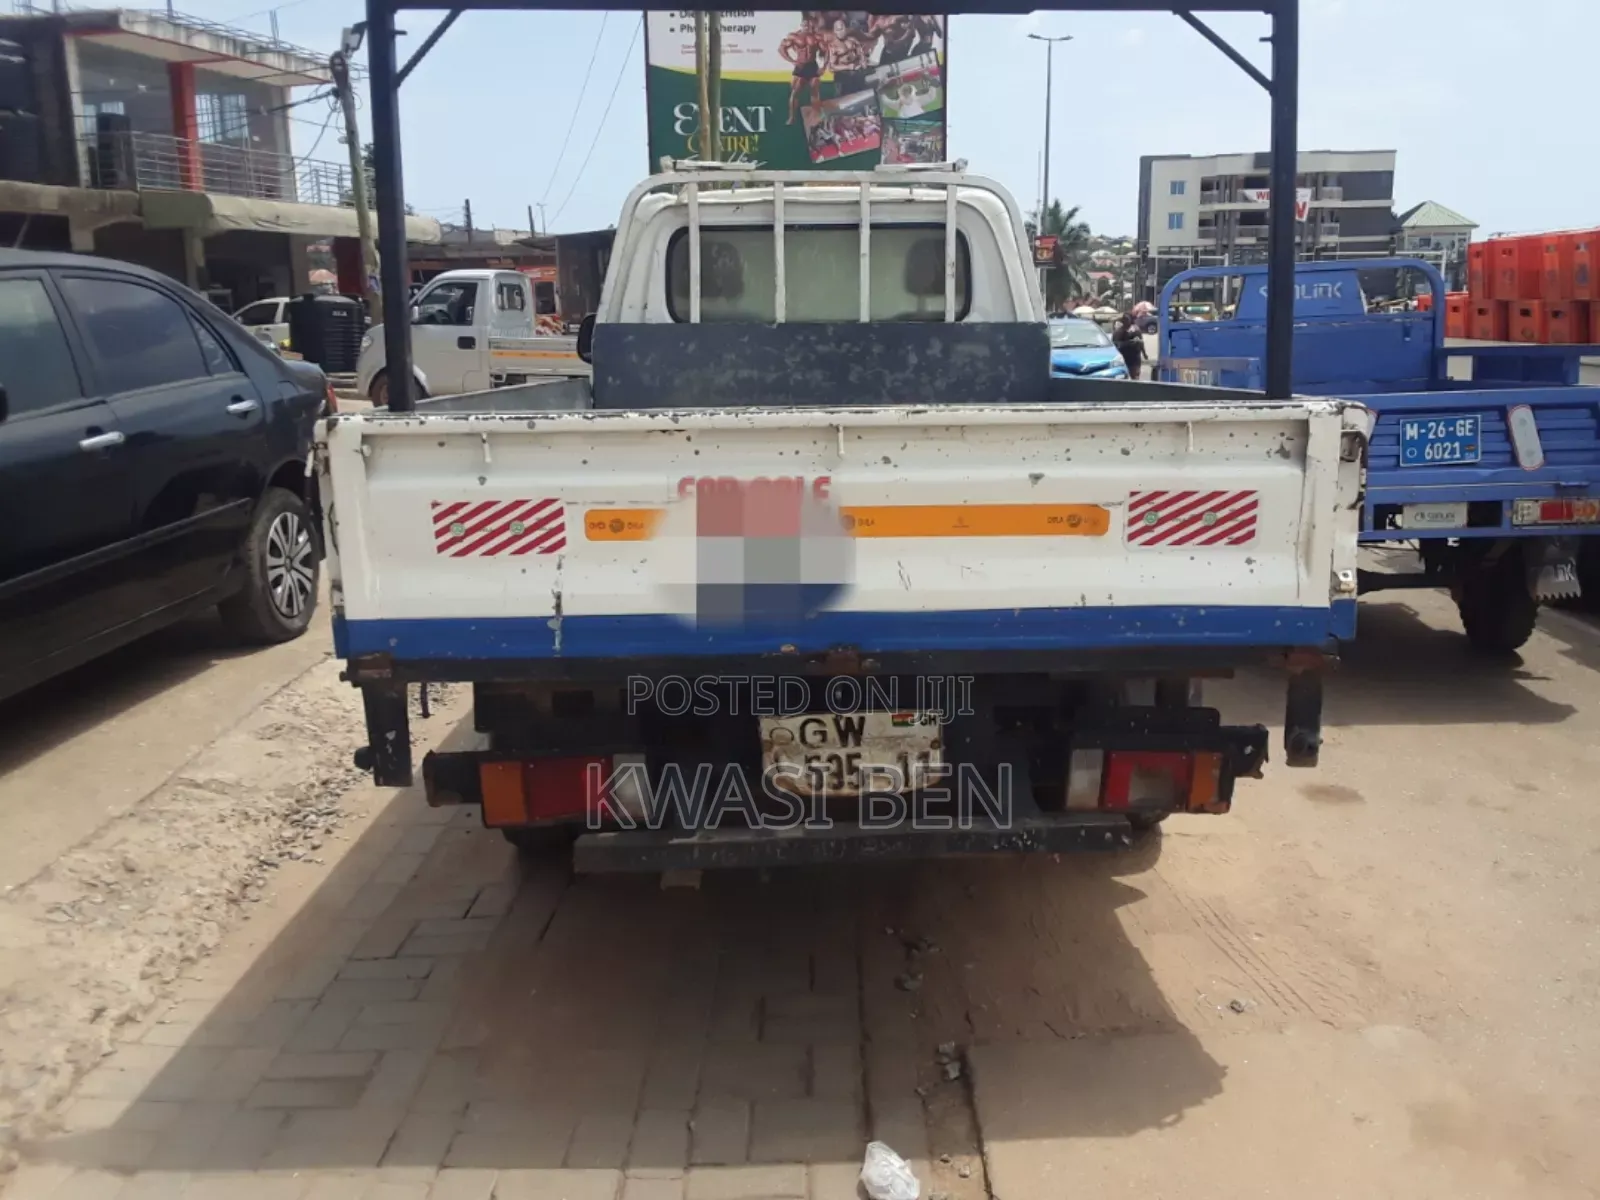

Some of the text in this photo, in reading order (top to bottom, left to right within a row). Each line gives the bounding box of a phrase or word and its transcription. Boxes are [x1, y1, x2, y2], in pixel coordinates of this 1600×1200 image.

[673, 101, 773, 136] EENT
[1424, 441, 1461, 460] 6021
[799, 714, 866, 749] GW
